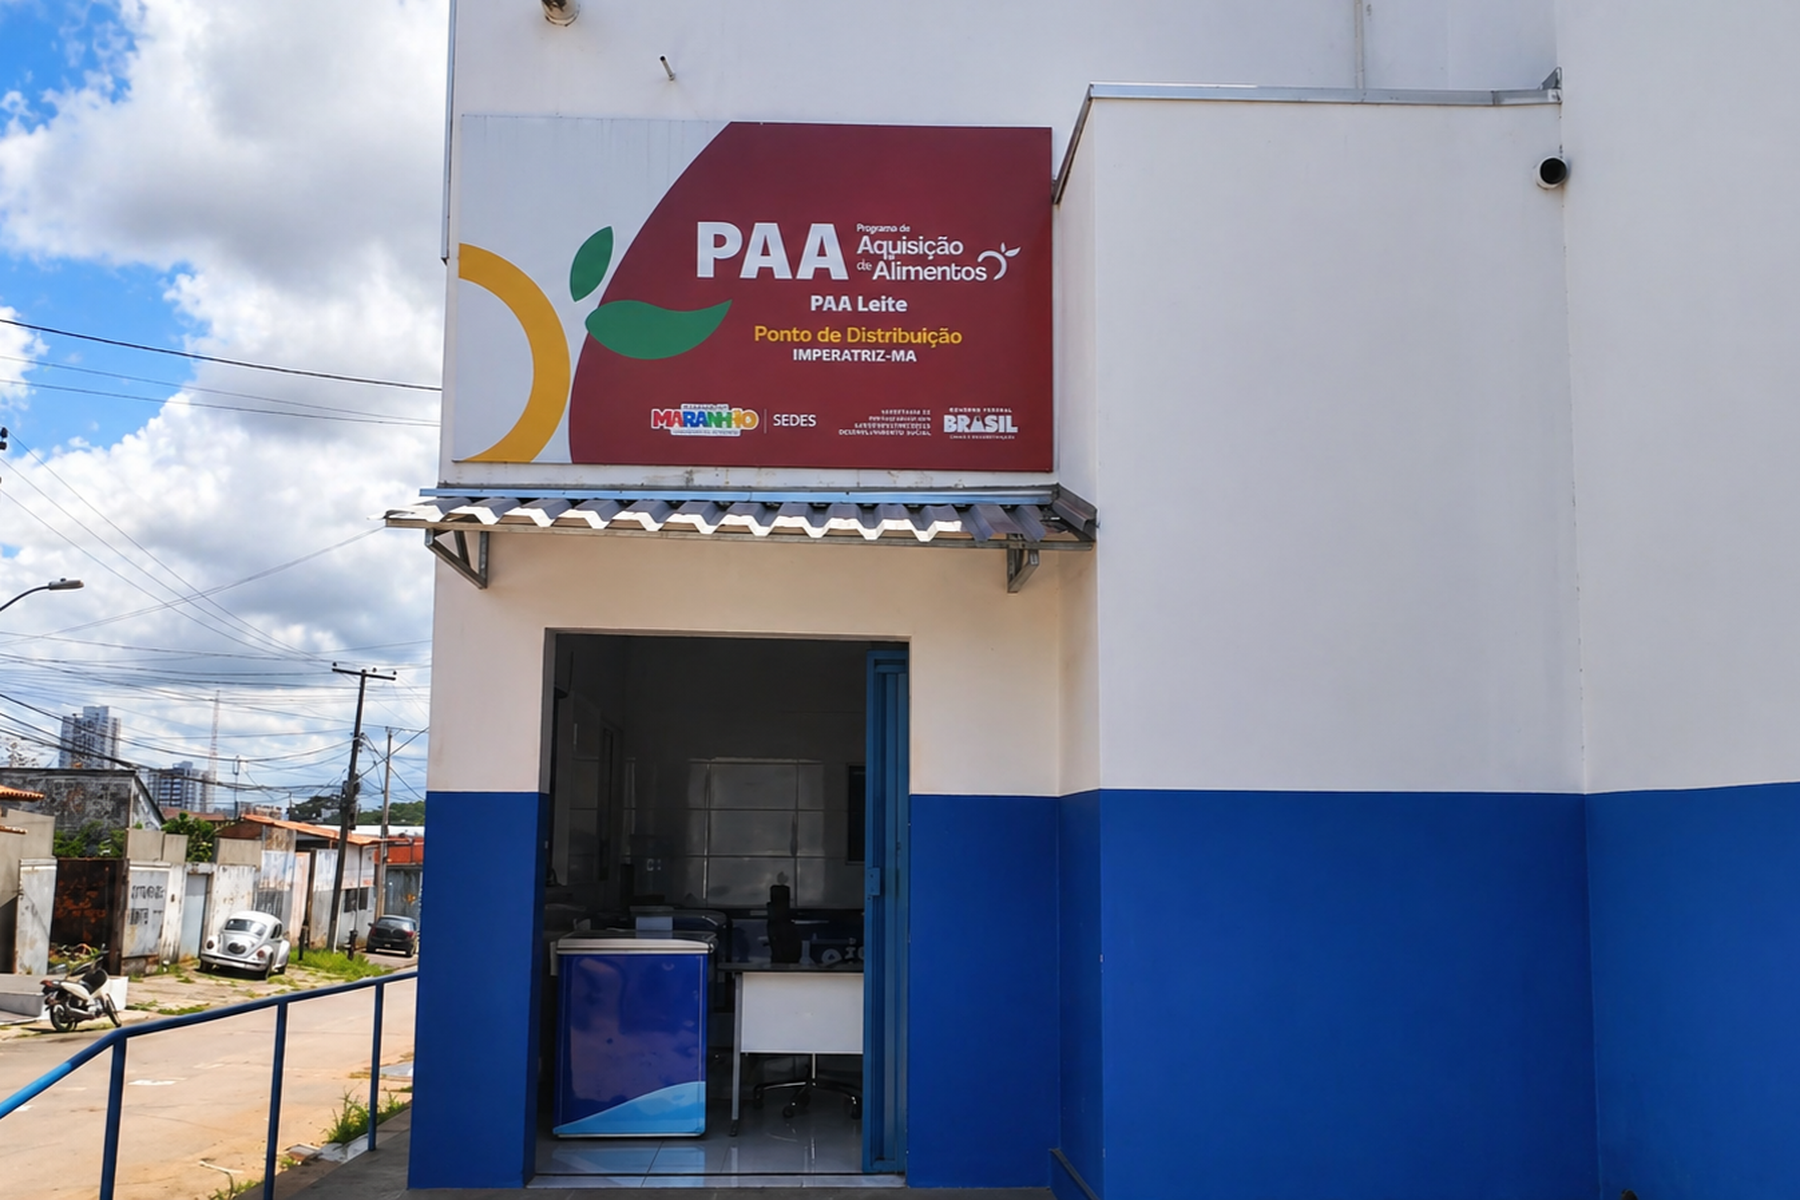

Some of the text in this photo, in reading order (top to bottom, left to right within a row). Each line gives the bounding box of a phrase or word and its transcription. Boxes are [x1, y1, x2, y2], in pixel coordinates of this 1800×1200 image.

[899, 224, 911, 233] de
[696, 221, 849, 280] PAA
[856, 235, 964, 261] Aquisição
[856, 259, 988, 281] de Alimentos
[810, 295, 908, 312] PAA Leite
[754, 325, 963, 348] Ponto de Distribuição
[793, 348, 917, 362] IMPERATRIZ-MA
[773, 413, 817, 427] SEDES
[943, 414, 1019, 433] BRASIL
